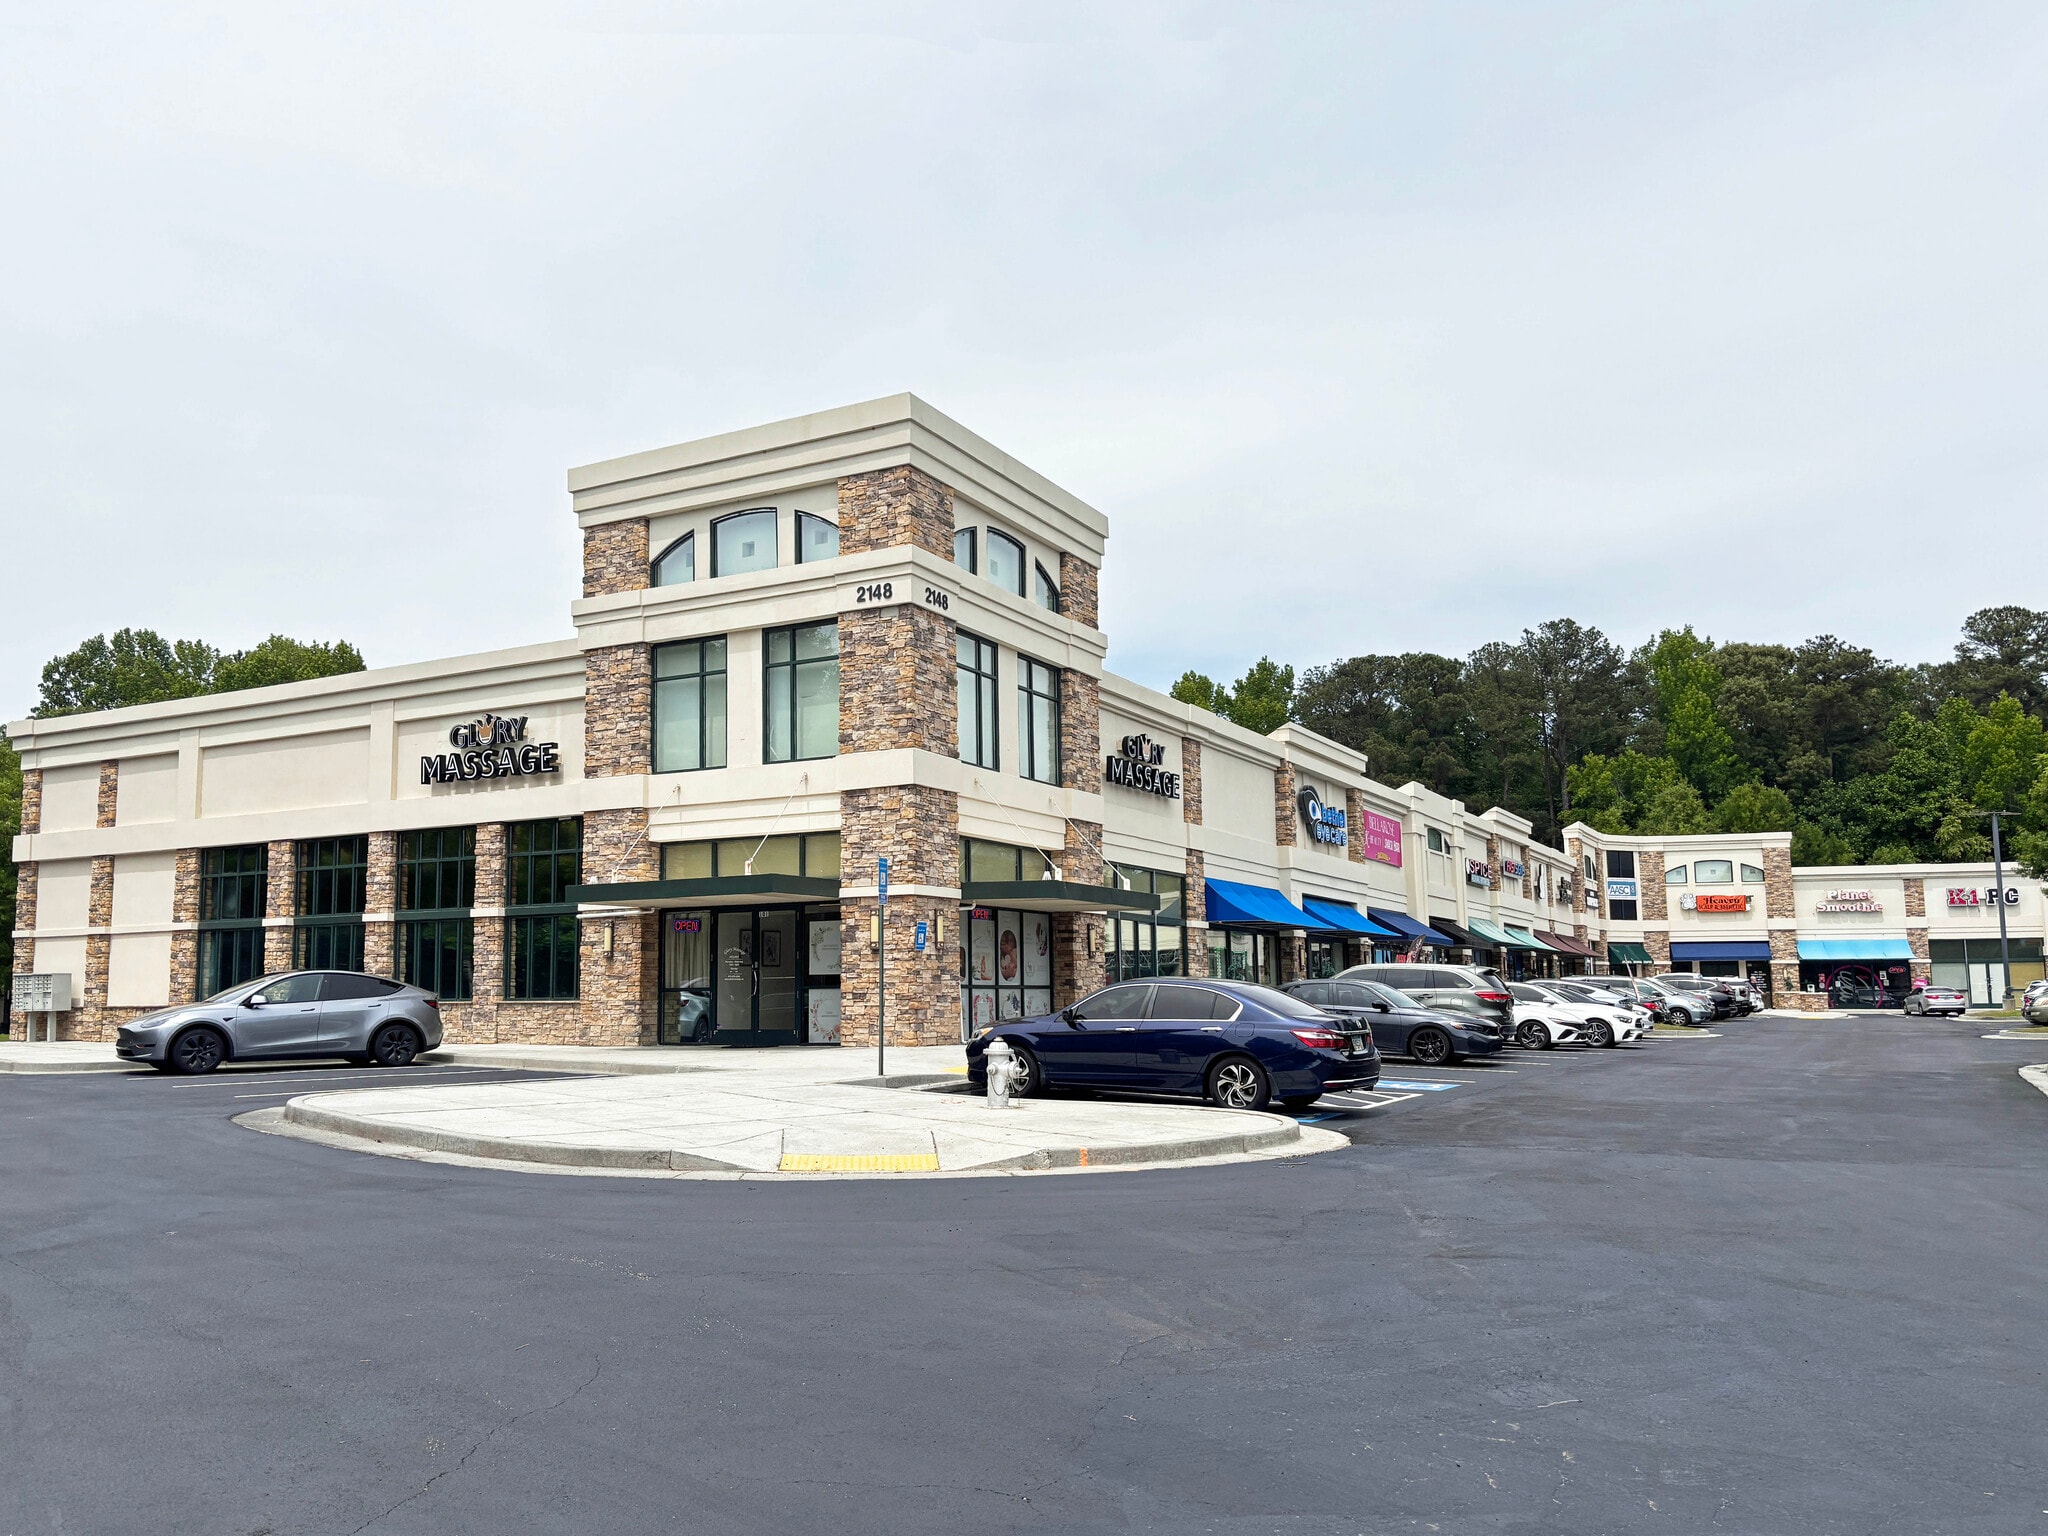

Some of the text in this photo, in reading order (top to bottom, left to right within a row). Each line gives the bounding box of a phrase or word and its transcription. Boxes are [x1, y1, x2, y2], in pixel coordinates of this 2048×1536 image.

[856, 582, 893, 603] 2148
[925, 587, 948, 611] 2148
[450, 714, 528, 748] GLORY
[1122, 733, 1165, 765] GLORY
[421, 742, 559, 784] MASSAGE
[1106, 755, 1180, 800] MASSAGE
[1469, 859, 1493, 879] SPICE
[1609, 884, 1629, 895] AASC
[1826, 888, 1874, 901] Planet
[972, 908, 989, 919] OPEN
[1816, 900, 1883, 913] Smoothie
[675, 921, 698, 931] OPEN
